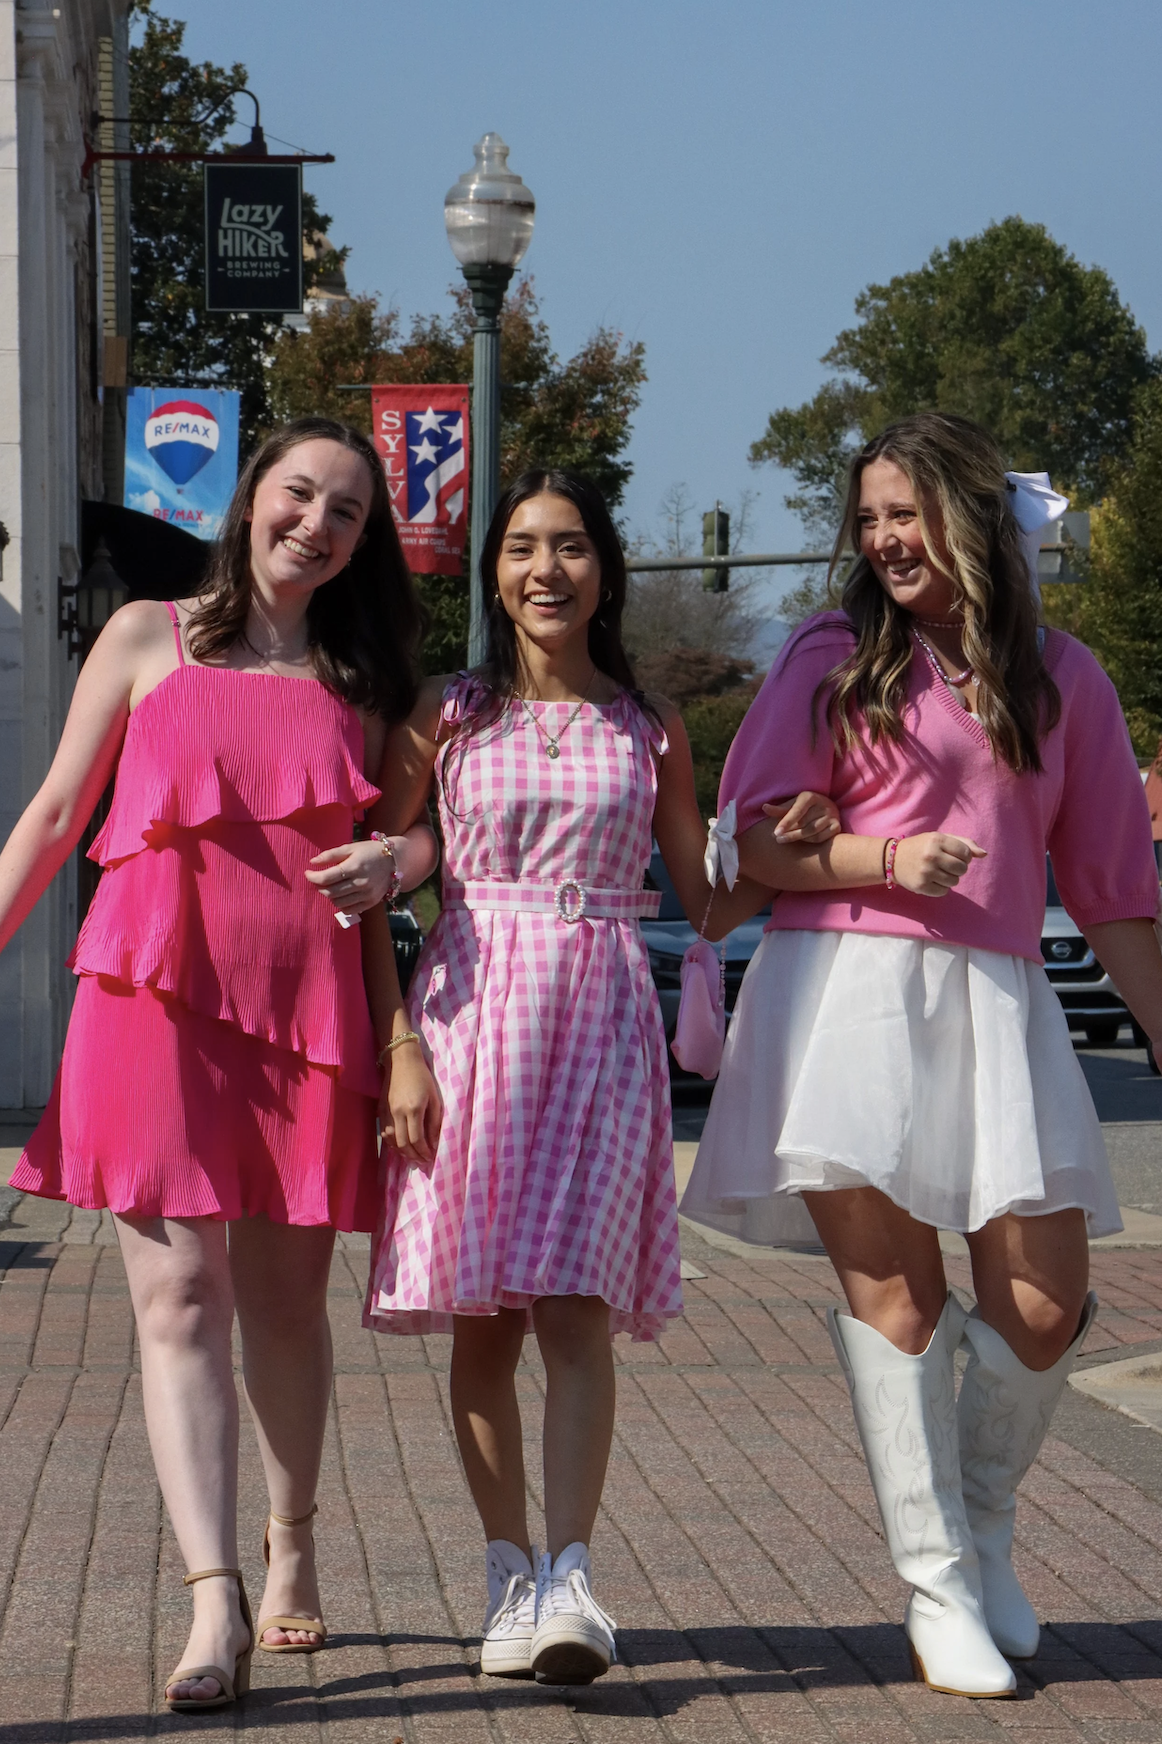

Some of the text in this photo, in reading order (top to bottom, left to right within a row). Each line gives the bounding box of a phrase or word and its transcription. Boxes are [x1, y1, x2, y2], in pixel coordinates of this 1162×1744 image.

[220, 197, 284, 231] Lazy
[218, 228, 289, 257] HIKER
[226, 261, 281, 269] BREWING
[227, 270, 281, 278] COMPANY
[154, 422, 211, 438] RE/MAX
[153, 508, 204, 522] RE/MAX
[418, 537, 429, 545] AIR
